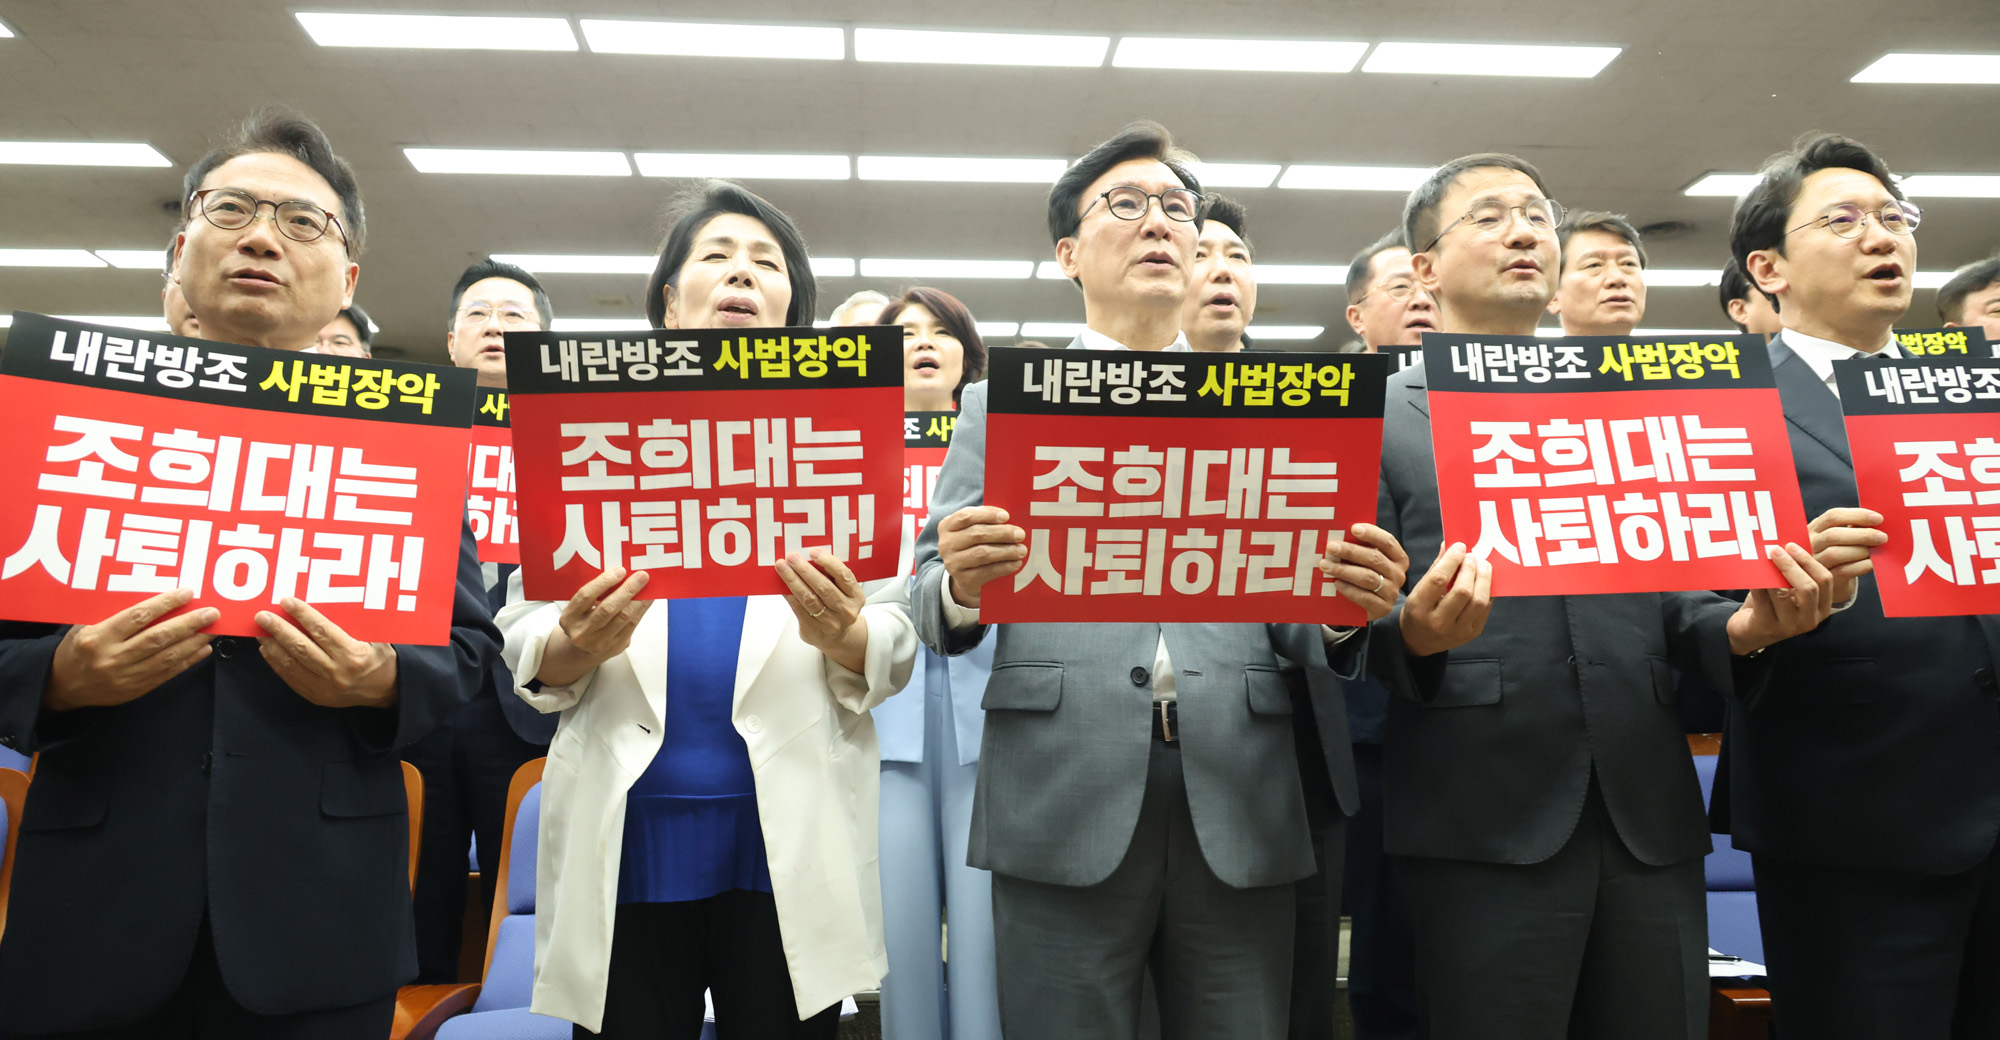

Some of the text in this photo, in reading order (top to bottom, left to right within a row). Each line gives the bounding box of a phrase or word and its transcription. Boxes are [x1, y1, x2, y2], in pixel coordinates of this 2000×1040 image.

[50, 330, 441, 414] 내란방조 사법장악
[540, 335, 871, 382] 내란방조 사법장악
[1450, 342, 1592, 384] 내란방조
[1598, 341, 1741, 381] 사법장악
[1894, 332, 1968, 355] 법장악
[1023, 359, 1355, 406] 내란방조 사법장악
[1864, 366, 2000, 404] 내란방조
[37, 415, 418, 526] 조희대는
[561, 418, 864, 492] 조희대는
[1030, 445, 1338, 520] 조희대는
[1470, 415, 1757, 489] 조희대는
[1, 504, 424, 613] 사퇴하라!
[552, 494, 875, 571] 사퇴하라!
[1470, 490, 1778, 567] 사퇴하라!
